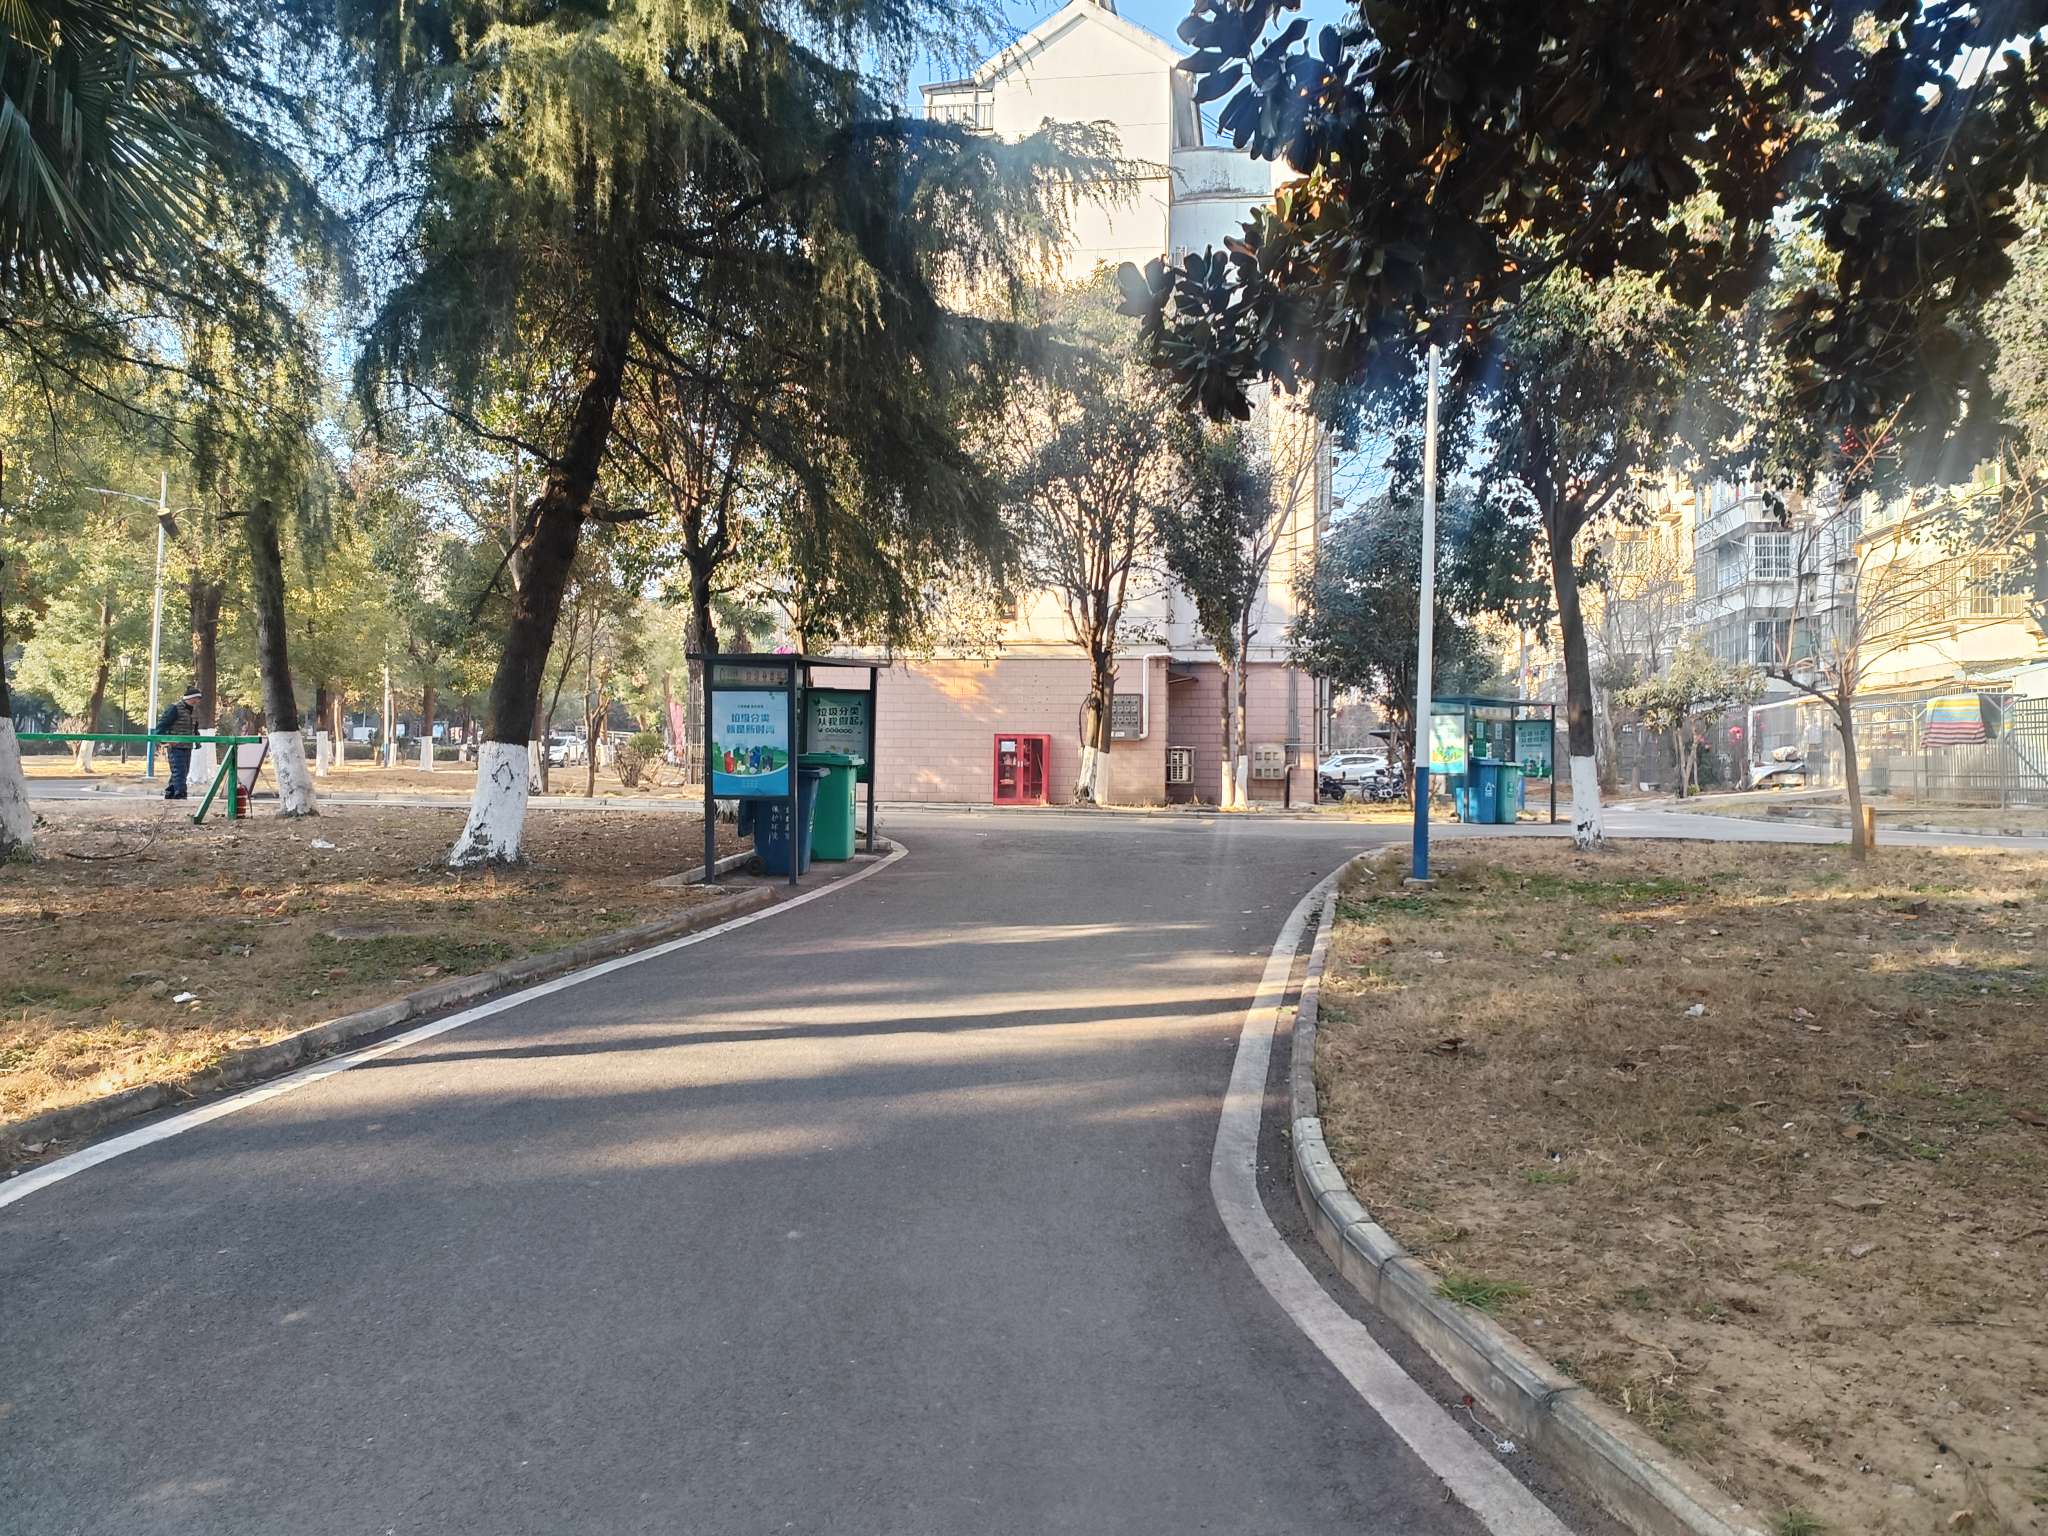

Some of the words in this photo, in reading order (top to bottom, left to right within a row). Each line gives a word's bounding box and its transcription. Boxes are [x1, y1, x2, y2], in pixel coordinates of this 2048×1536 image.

[816, 706, 859, 716] 垃圾分类
[732, 713, 769, 723] 垃圾分类
